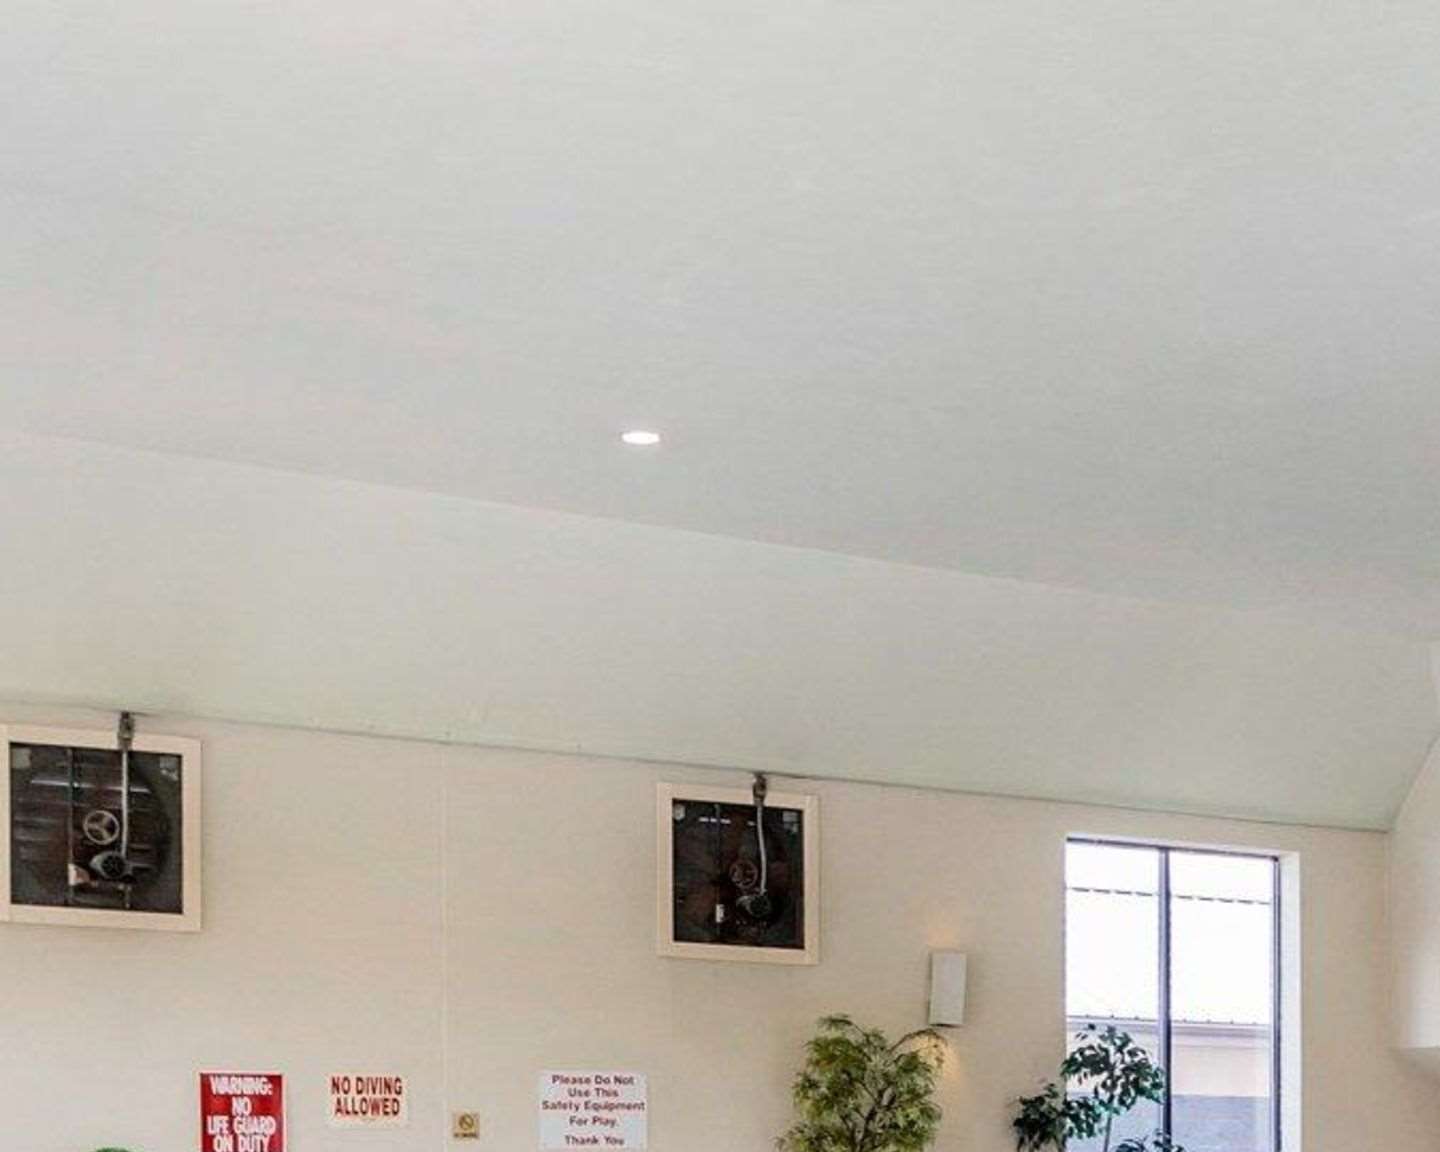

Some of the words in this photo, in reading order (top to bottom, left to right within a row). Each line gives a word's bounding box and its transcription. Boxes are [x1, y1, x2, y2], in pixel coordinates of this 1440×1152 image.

[209, 1075, 274, 1096] WARNING:
[331, 1076, 350, 1095] NO
[355, 1077, 403, 1095] DIVING
[551, 1074, 592, 1085] Please
[594, 1075, 611, 1085] Do
[613, 1075, 635, 1086] Not
[567, 1087, 591, 1098] Use
[594, 1087, 619, 1098] This
[231, 1096, 252, 1116] NO
[334, 1097, 401, 1116] ALLOWED
[541, 1100, 580, 1112] Safety
[583, 1100, 646, 1113] Equipment
[206, 1115, 230, 1135] LIFE
[233, 1115, 276, 1136] GUARD
[569, 1115, 589, 1126] For
[212, 1134, 234, 1152] ON
[237, 1134, 270, 1152] DUTY
[564, 1134, 600, 1146] Thank
[603, 1134, 625, 1146] You
